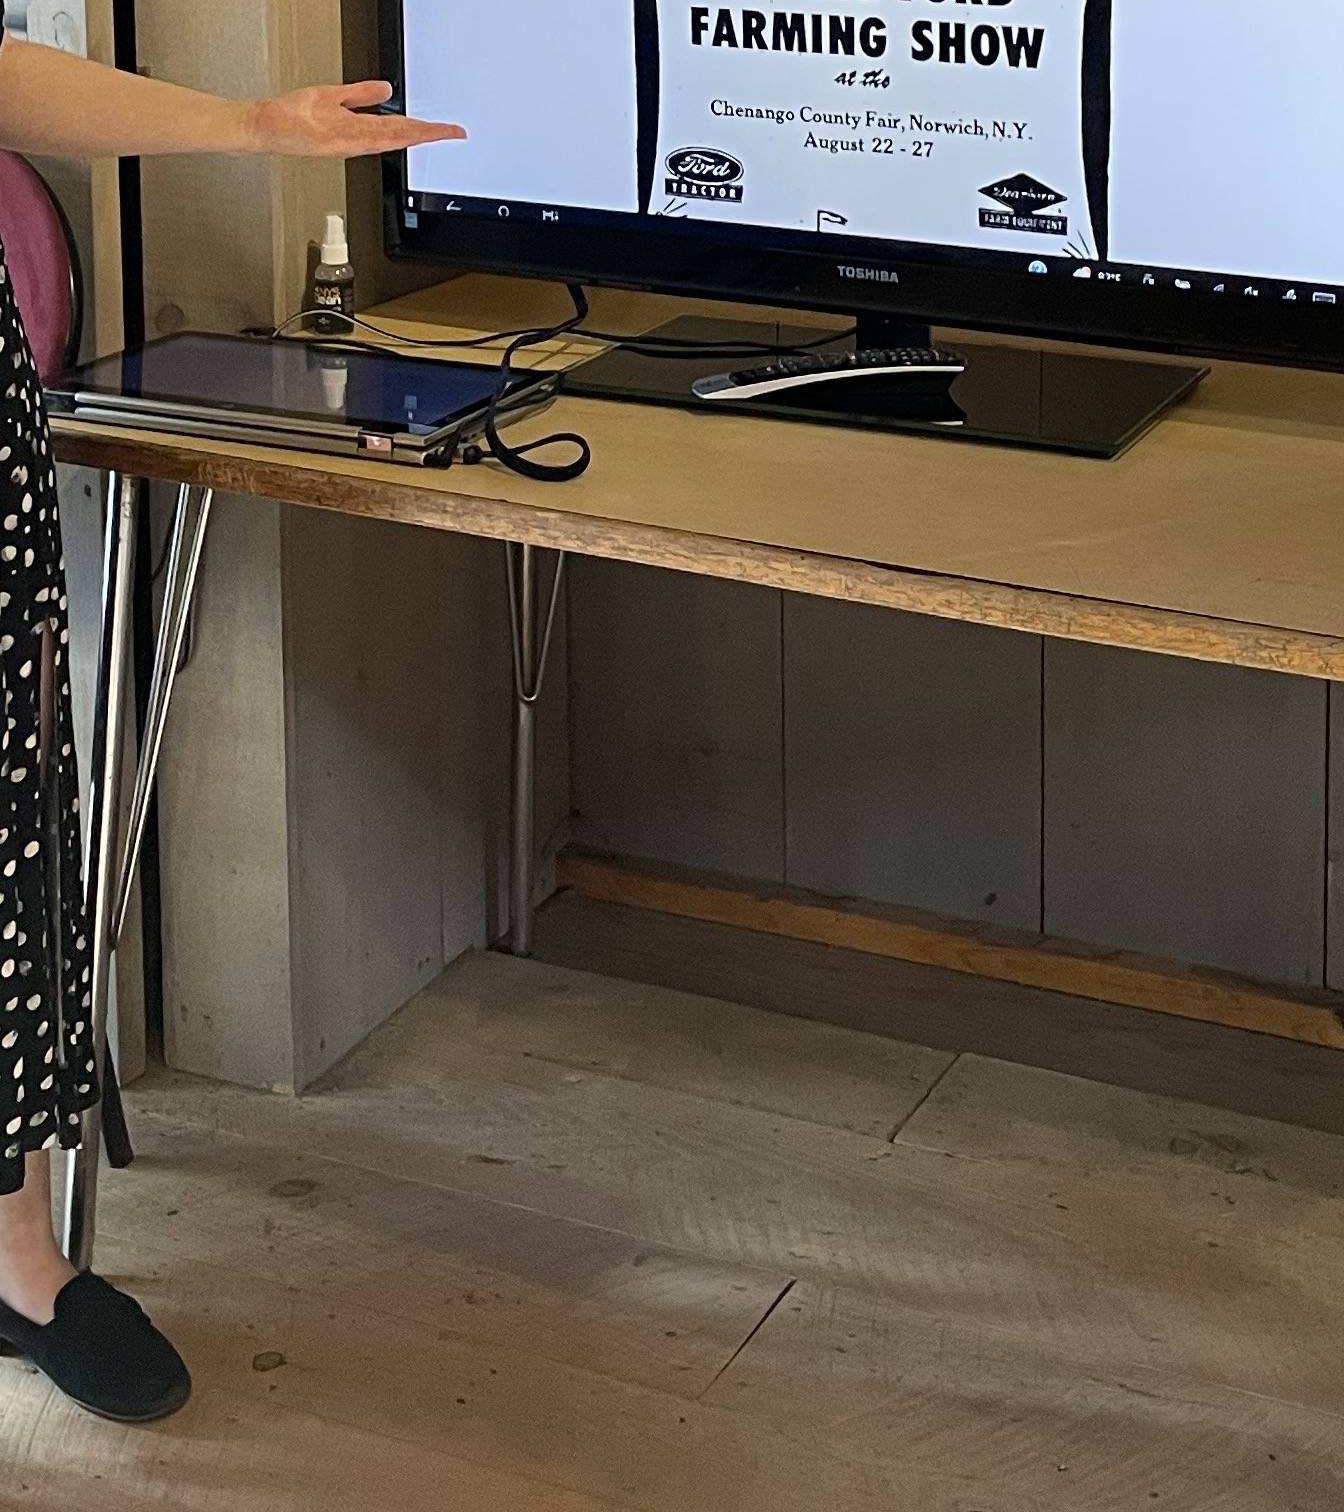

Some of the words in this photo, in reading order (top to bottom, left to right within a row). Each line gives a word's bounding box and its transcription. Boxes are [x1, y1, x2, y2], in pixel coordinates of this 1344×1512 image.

[690, 6, 888, 59] FARMING
[911, 20, 1045, 69] SHOW
[834, 72, 856, 88] at
[859, 68, 891, 90] the
[710, 99, 795, 125] Chenango
[799, 106, 862, 131] County
[865, 110, 906, 133] Fair,
[909, 114, 990, 138] Norwich,
[991, 121, 1034, 141] N.Y.
[804, 132, 865, 154] August
[871, 138, 895, 156] 22
[911, 141, 935, 159] 27
[678, 153, 730, 176] Ford
[672, 182, 736, 199] TRACTOR
[837, 265, 899, 284] TOSHIBA
